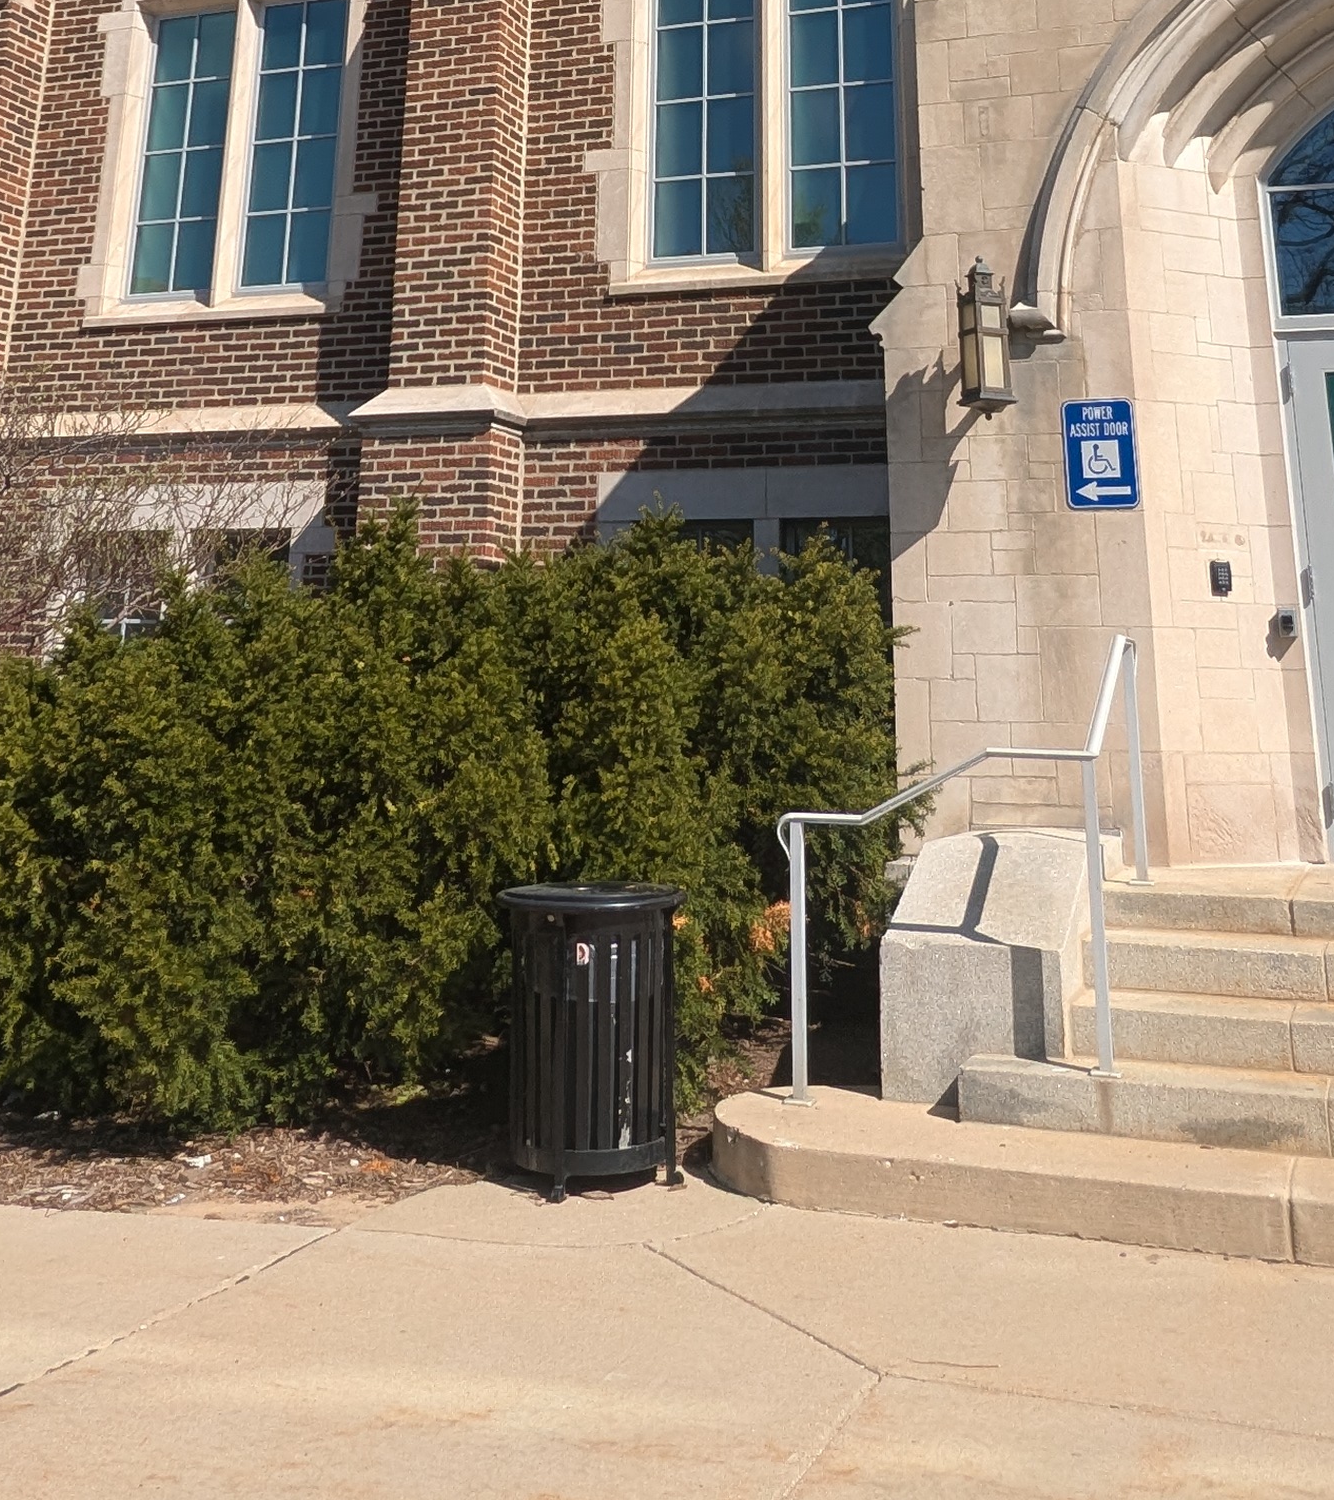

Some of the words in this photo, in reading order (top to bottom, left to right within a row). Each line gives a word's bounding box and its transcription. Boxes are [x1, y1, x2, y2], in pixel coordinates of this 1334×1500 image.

[1081, 405, 1113, 421] POWER
[1069, 422, 1100, 438] ASSIST
[1103, 421, 1129, 436] DOOR
